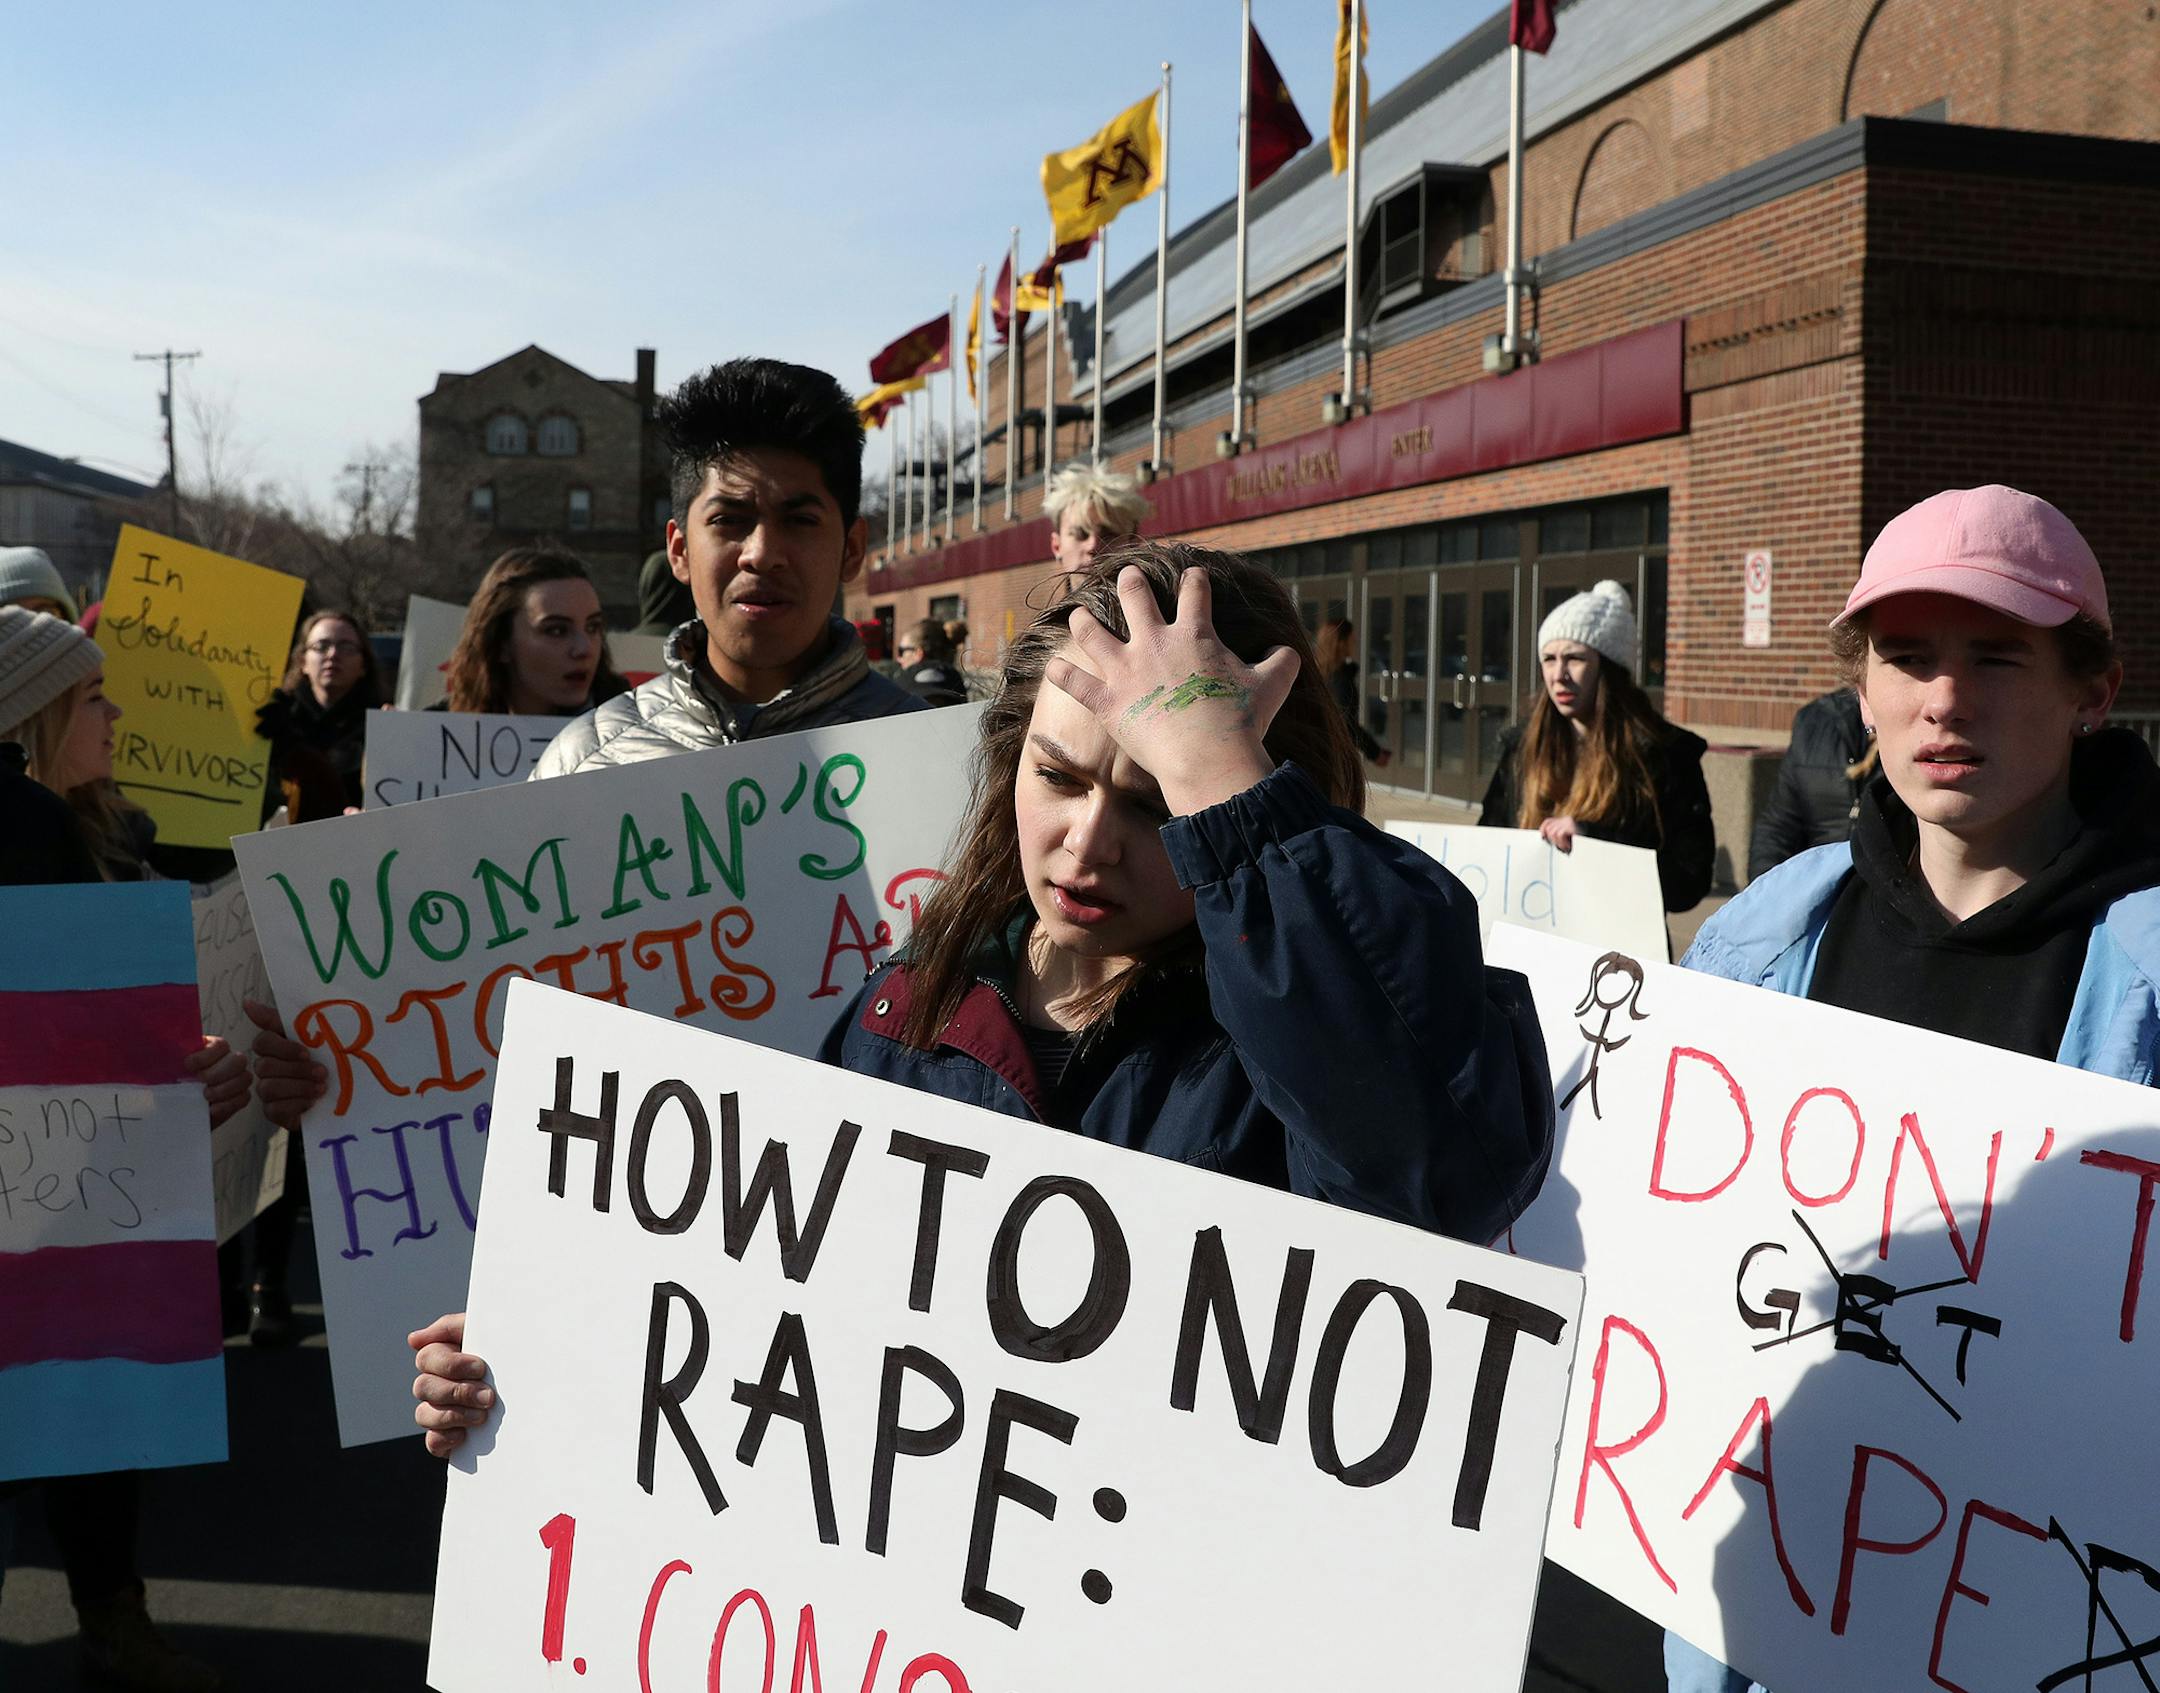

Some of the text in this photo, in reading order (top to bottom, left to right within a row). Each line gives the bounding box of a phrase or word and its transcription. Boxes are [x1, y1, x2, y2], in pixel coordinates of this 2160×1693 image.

[132, 551, 184, 593] In
[105, 596, 276, 705] Solidarity
[144, 677, 225, 713] WITH
[112, 731, 265, 790] URVIVORS
[266, 752, 867, 984] WOMAN'S
[40, 1093, 143, 1143] not
[1649, 1046, 2160, 1344] DON'T
[537, 1056, 863, 1284] HOW
[886, 1129, 1132, 1364] TO
[1169, 1225, 1569, 1532] NOT
[635, 1281, 1128, 1630] RAPE:
[538, 1512, 590, 1675] 1.
